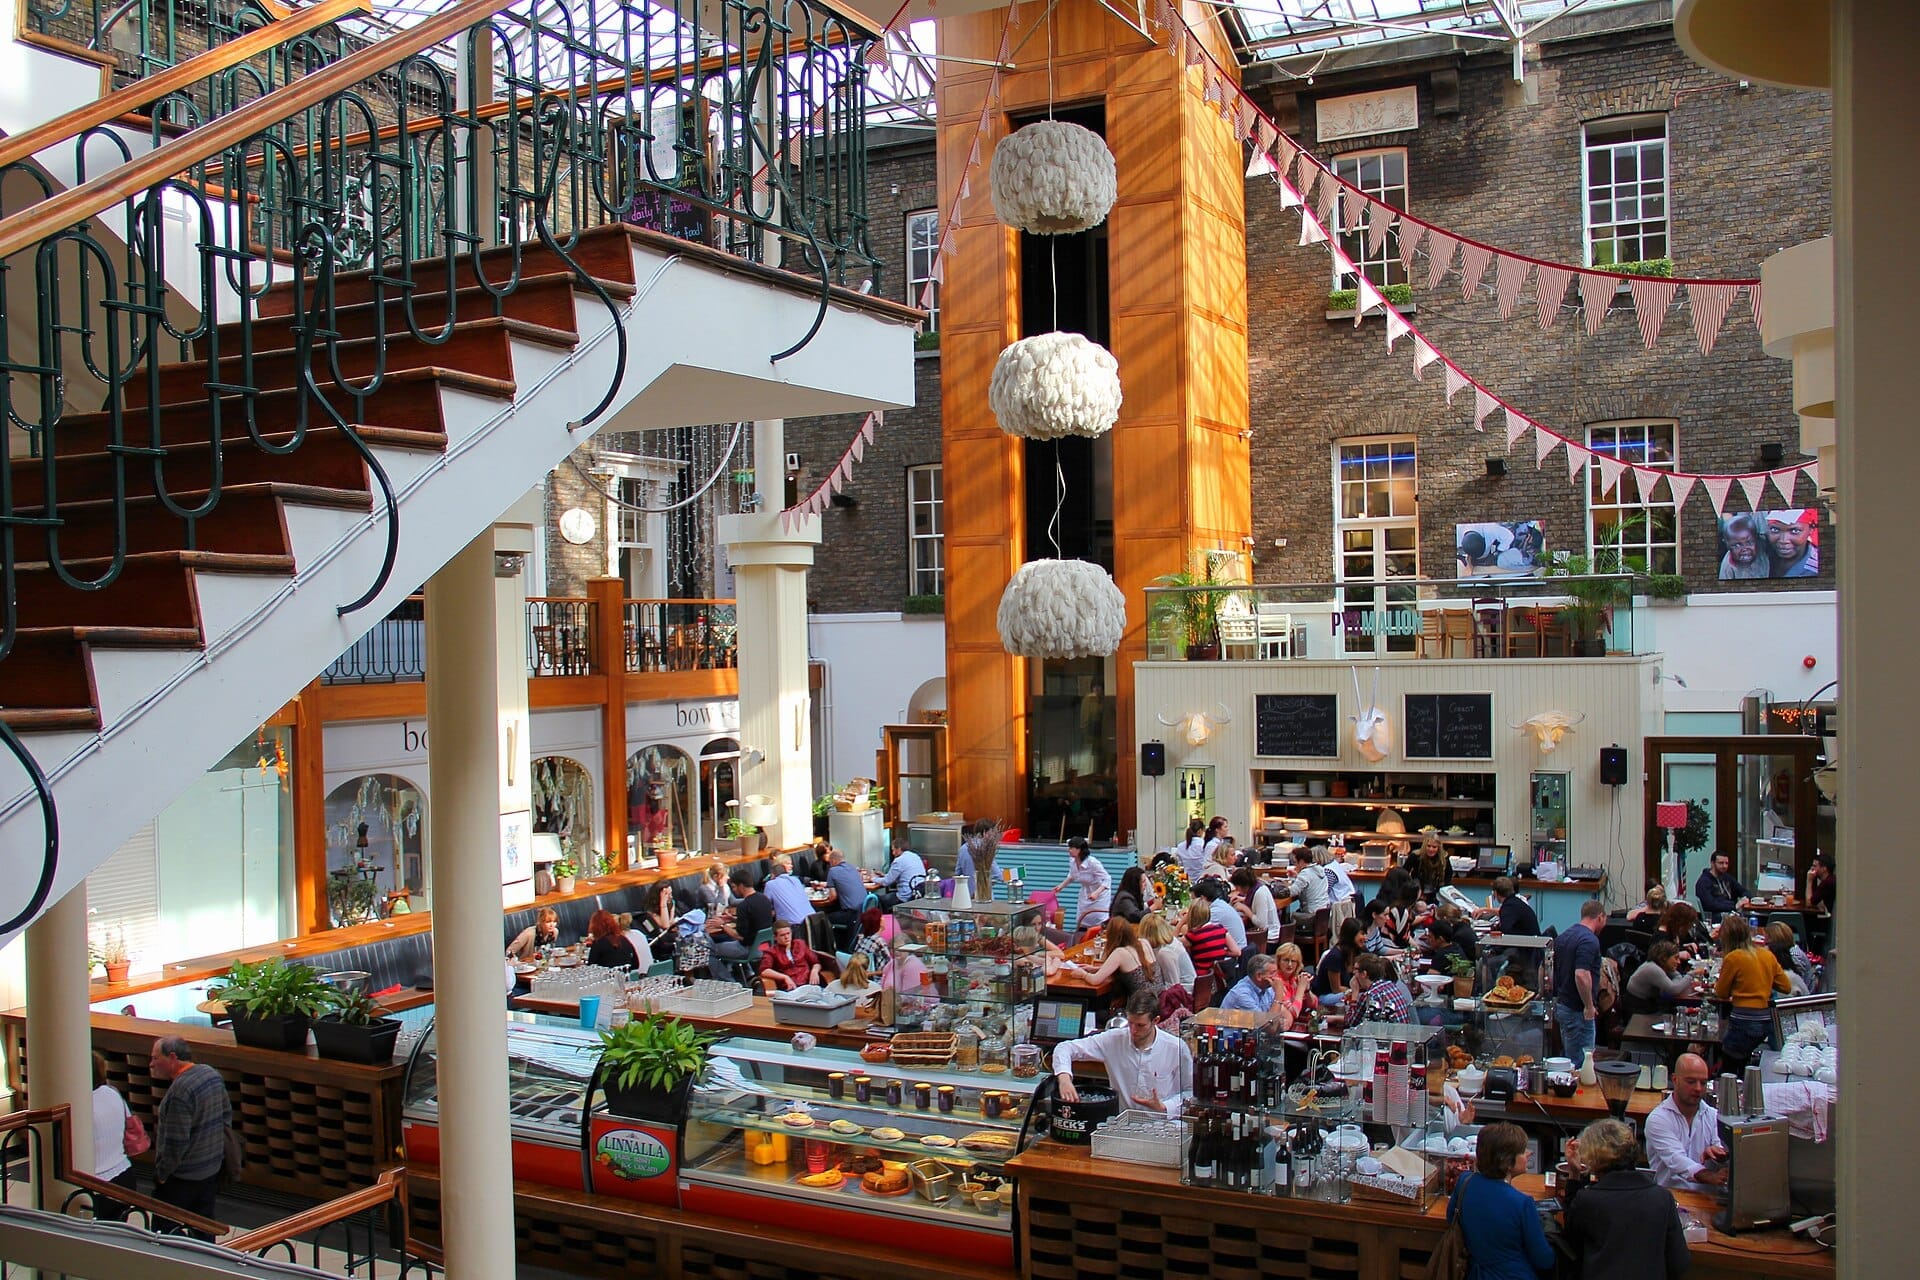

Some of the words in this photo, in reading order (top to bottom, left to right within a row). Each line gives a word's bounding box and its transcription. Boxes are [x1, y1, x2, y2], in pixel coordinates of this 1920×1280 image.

[631, 205, 653, 222] daily
[1053, 1117, 1086, 1130] BECK'S
[604, 1136, 665, 1158] LINNALLA
